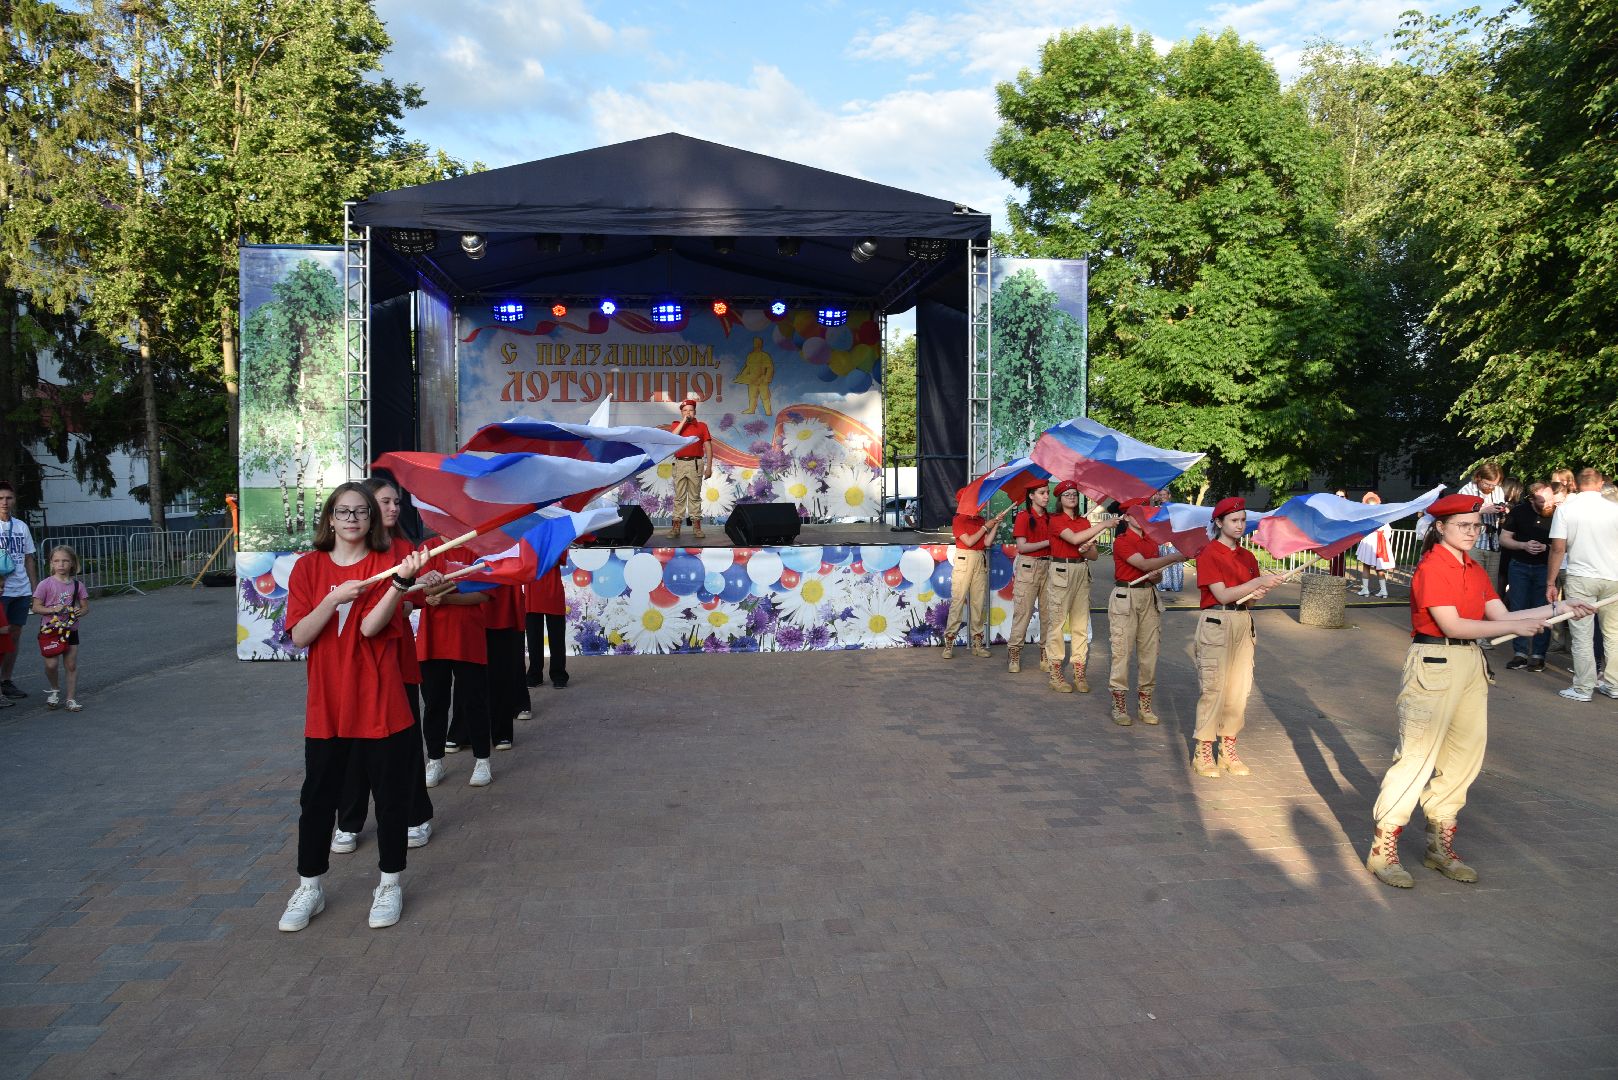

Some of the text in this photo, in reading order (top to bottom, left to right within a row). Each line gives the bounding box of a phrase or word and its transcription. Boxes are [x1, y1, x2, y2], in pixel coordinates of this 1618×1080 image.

[500, 342, 722, 370] С ПРАЗДНИКОМ,
[499, 369, 724, 404] ЛОТОШИНО!
